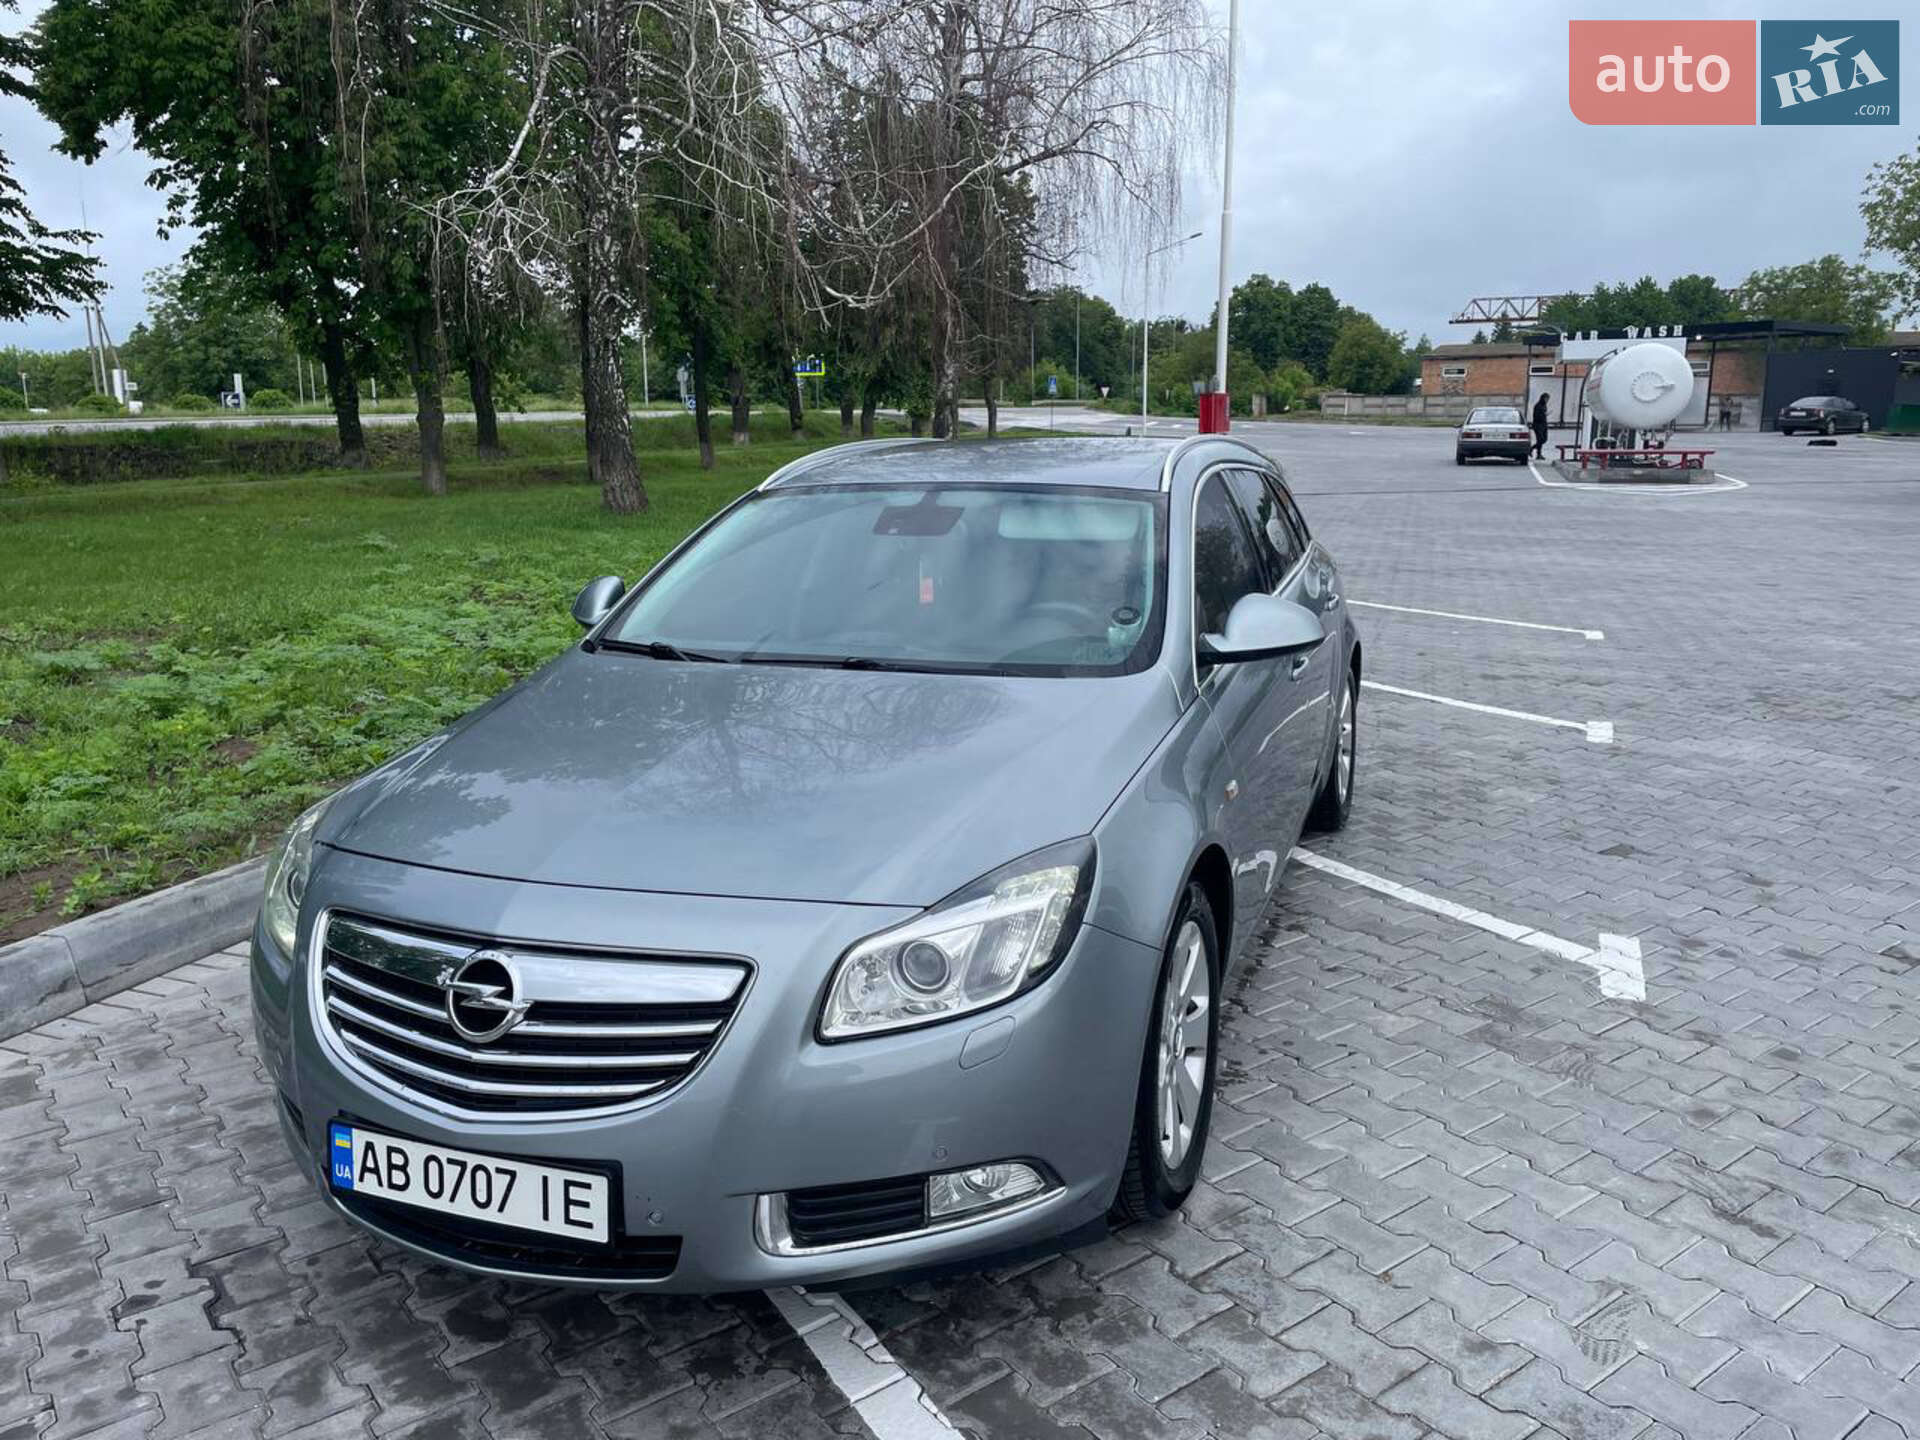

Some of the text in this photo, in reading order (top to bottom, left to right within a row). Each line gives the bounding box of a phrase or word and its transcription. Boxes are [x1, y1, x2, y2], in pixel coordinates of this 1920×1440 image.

[1560, 325, 1684, 343] CAR WASH
[335, 1163, 351, 1180] UA
[358, 1141, 594, 1230] AB 0707 IE
